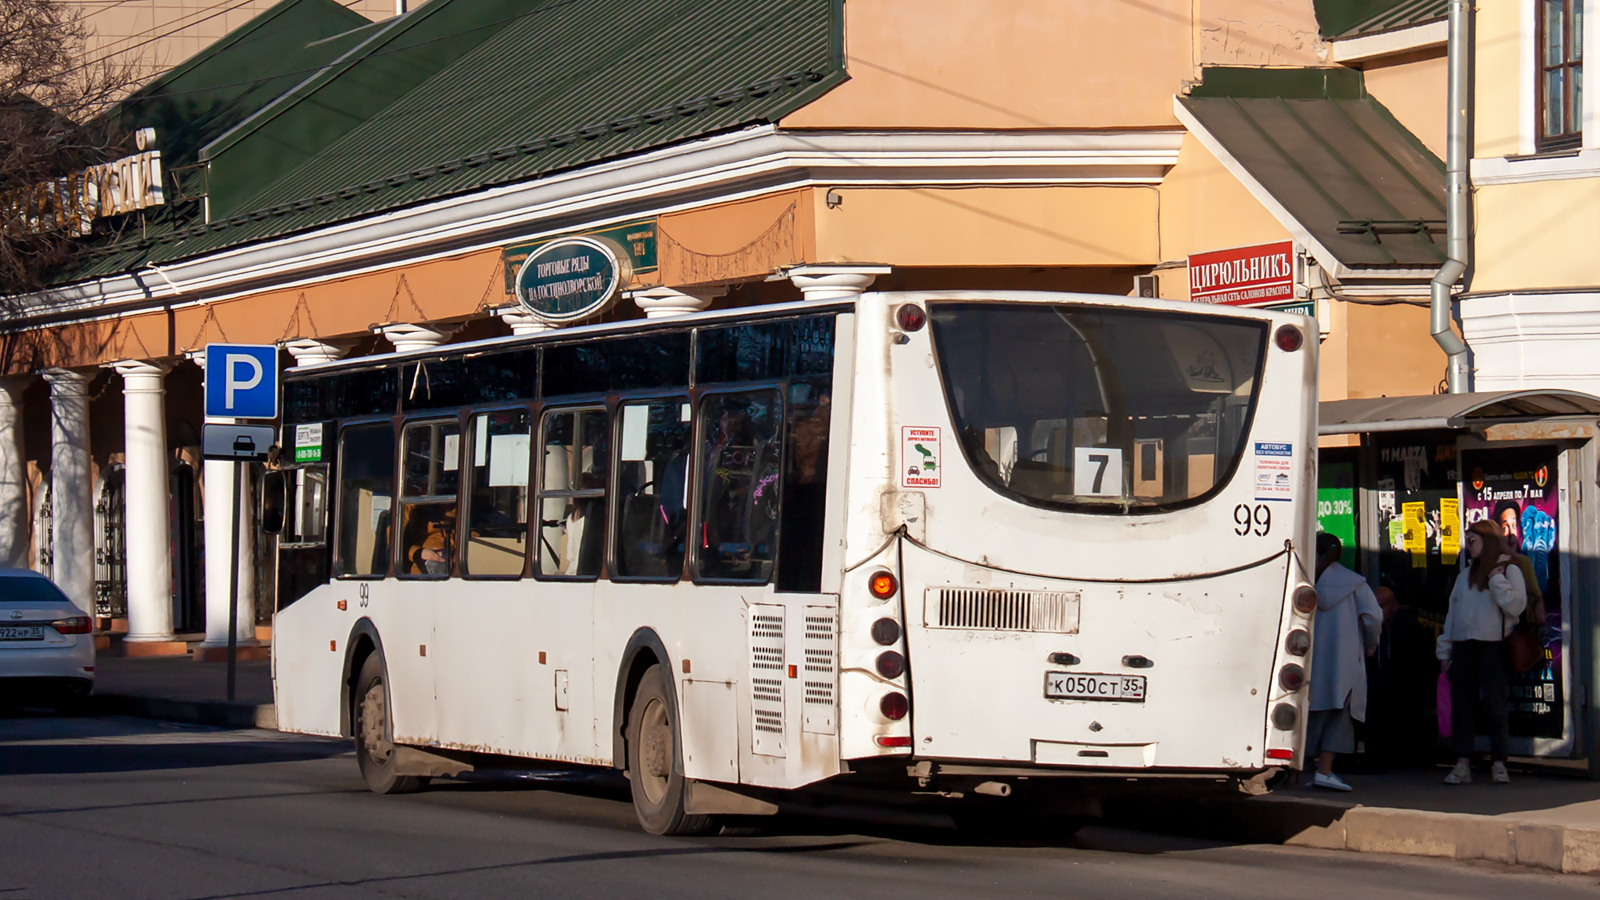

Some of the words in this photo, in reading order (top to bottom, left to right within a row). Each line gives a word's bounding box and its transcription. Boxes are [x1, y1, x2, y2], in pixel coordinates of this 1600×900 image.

[537, 260, 571, 278] ТОРГОВЫЕ
[571, 255, 590, 271] РЯДЫ
[1191, 253, 1291, 292] ЦИРЮЛЬНИКЪ
[528, 286, 538, 301] НА
[538, 273, 602, 299] ГОСТИНОДВОРСКОЙ
[1228, 291, 1241, 302] СЕТЬ
[1241, 288, 1265, 300] САЛОНОВ
[1266, 285, 1291, 297] КРАСОТЫ
[225, 353, 263, 409] P
[906, 477, 938, 485] СПАСИБО!
[1088, 454, 1109, 493] 7
[1483, 486, 1492, 501] 15
[1493, 491, 1513, 500] АПРЕЛЯ
[1514, 490, 1522, 499] ПО
[1523, 484, 1529, 499] 7
[1530, 489, 1543, 498] МАЯ
[1233, 503, 1271, 537] 99
[1318, 500, 1332, 517] ДО
[1333, 500, 1352, 515] 30%
[359, 582, 368, 607] 99
[1055, 677, 1118, 695] К050СТ
[1123, 679, 1138, 691] 35
[1534, 685, 1543, 698] 10
